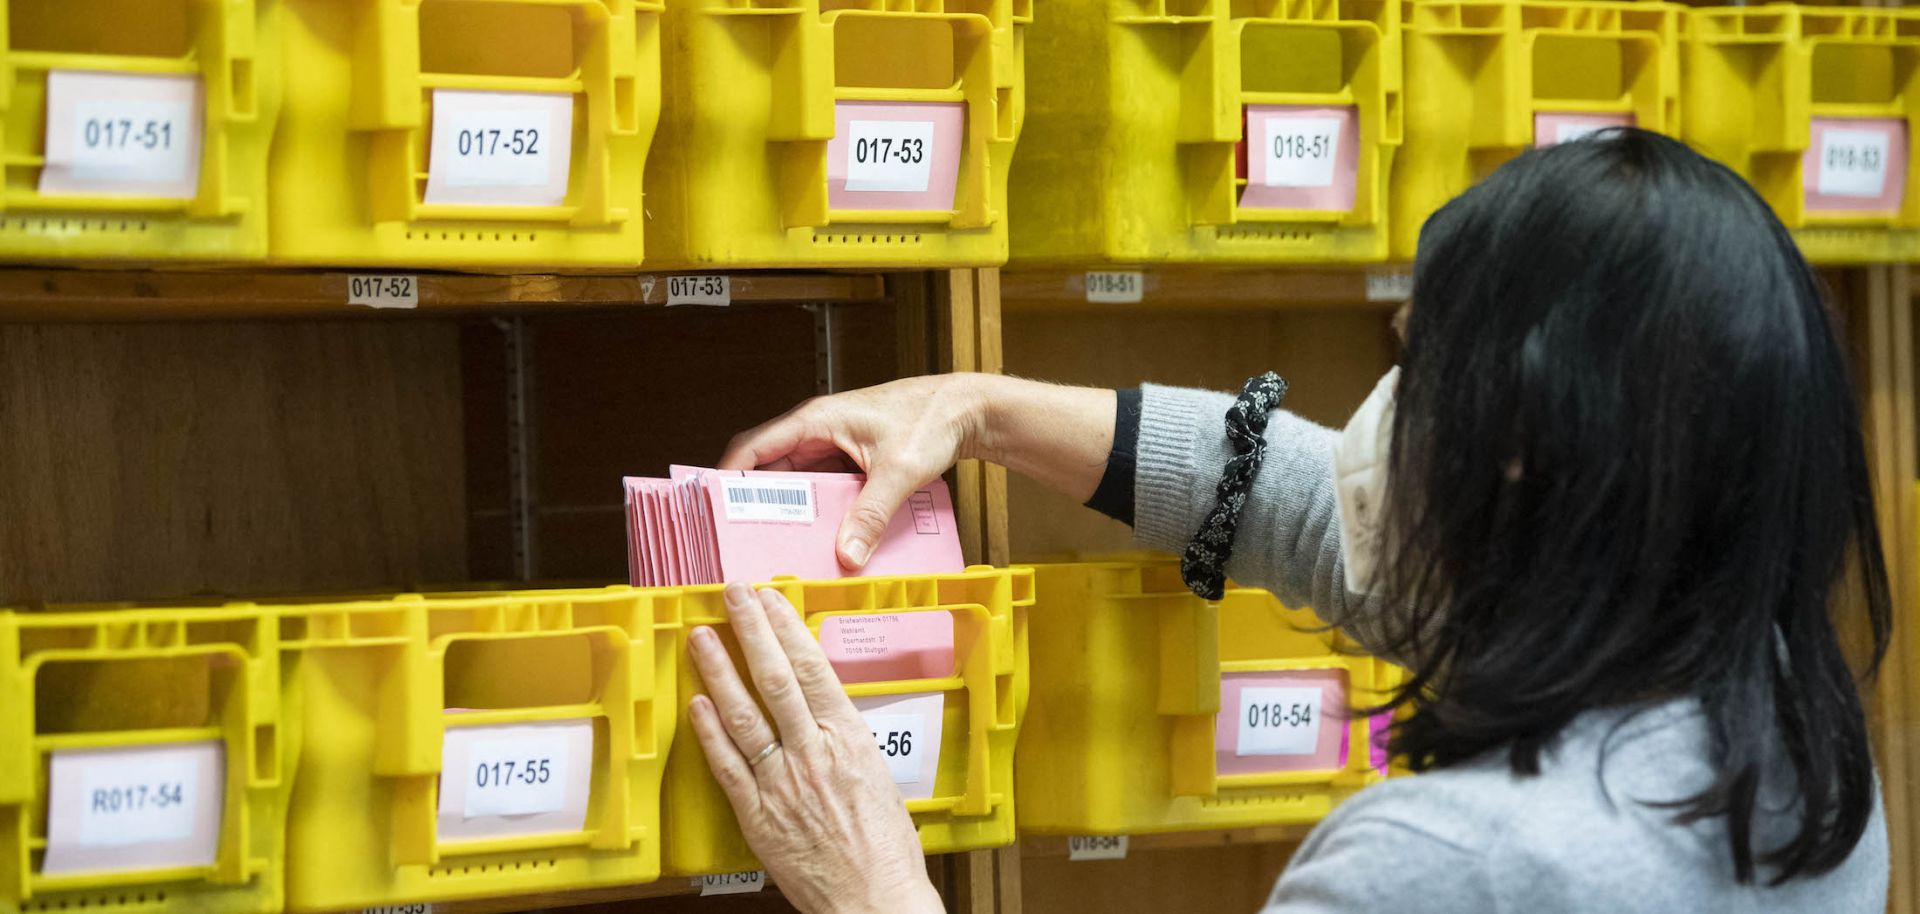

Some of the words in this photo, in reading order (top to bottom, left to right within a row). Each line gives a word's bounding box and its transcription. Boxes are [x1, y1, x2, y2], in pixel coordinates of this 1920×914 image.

[85, 118, 173, 149] 017-51
[458, 129, 539, 156] 017-52
[1273, 134, 1331, 159] 018-51
[856, 138, 924, 164] 017-53
[351, 277, 412, 299] 017-52
[671, 276, 723, 297] 017-53
[1248, 702, 1312, 728] 018-54
[477, 758, 550, 788] 017-55
[91, 784, 183, 814] R017-54
